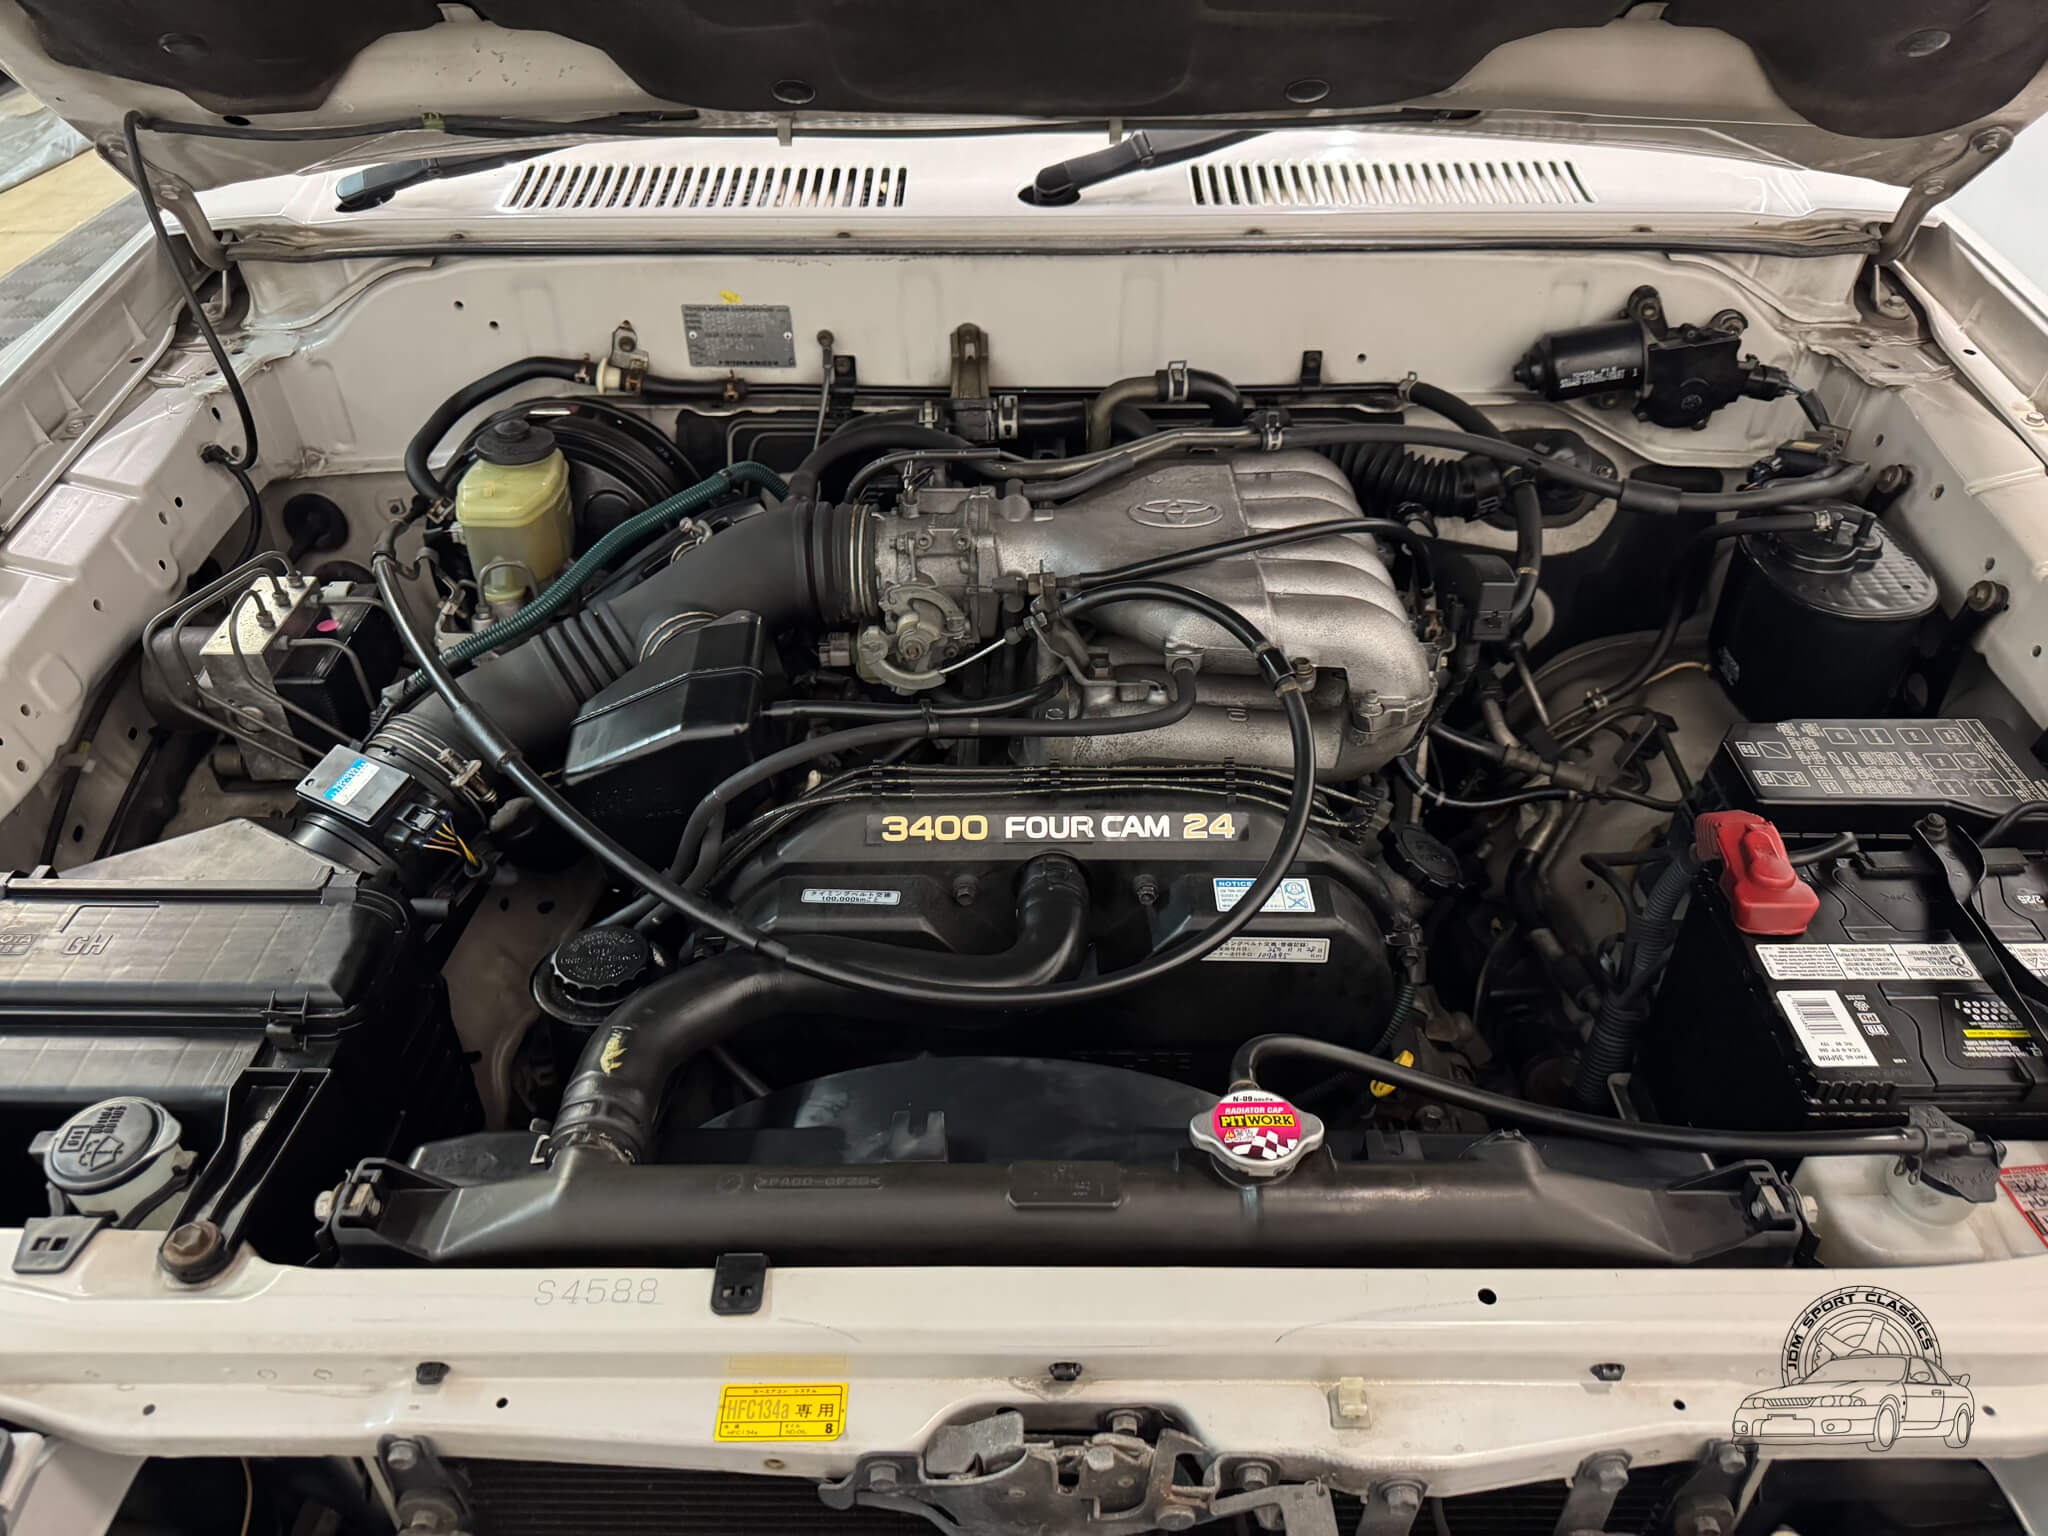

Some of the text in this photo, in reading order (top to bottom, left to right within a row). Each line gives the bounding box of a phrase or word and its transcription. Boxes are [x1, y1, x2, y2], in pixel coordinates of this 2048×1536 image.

[881, 813, 1235, 841] 3400 FOUR CAM 24
[2017, 894, 2044, 905] 2/25
[61, 934, 115, 955] GH
[1266, 1106, 1285, 1114] CAP
[1221, 1114, 1294, 1127] PITWORK
[534, 1278, 658, 1306] S4588
[726, 1400, 835, 1420] HFC134a 専用
[825, 1423, 833, 1434] 8
